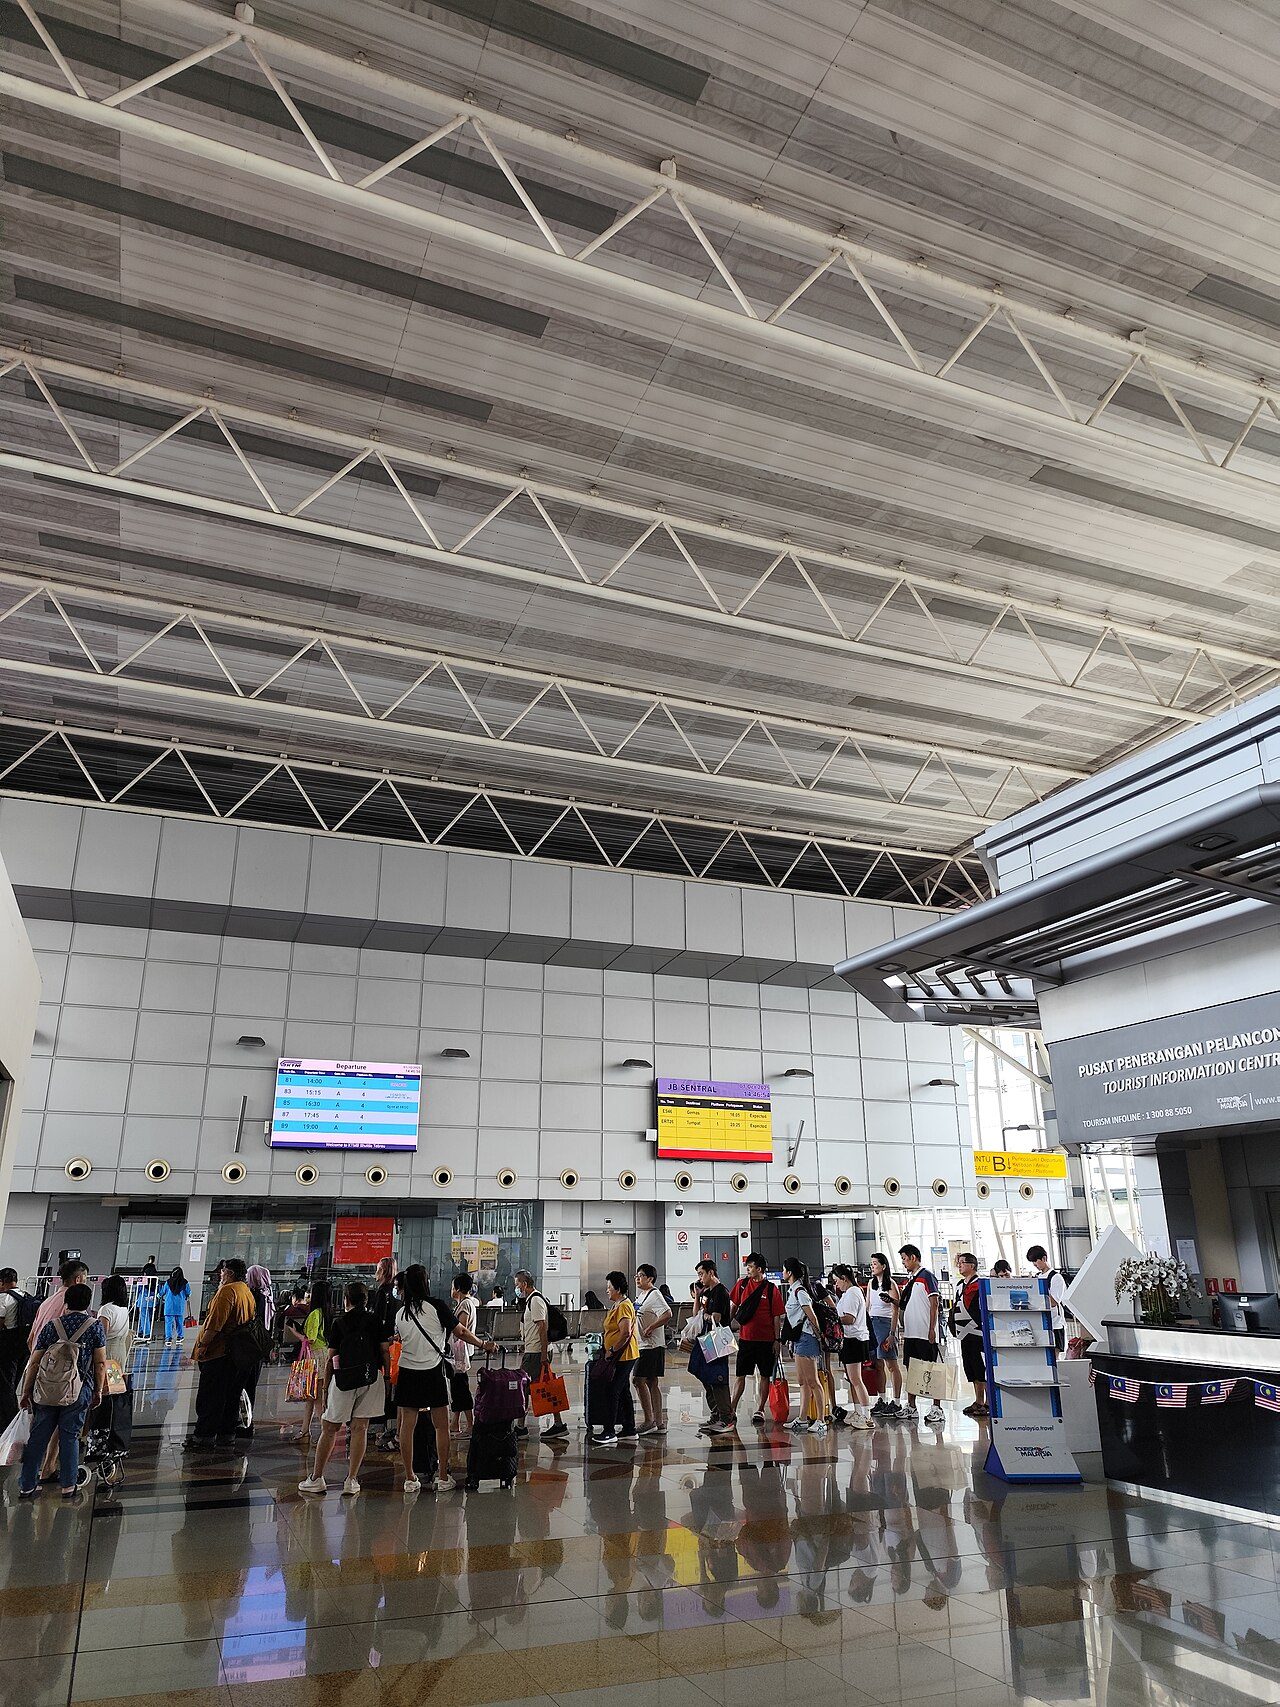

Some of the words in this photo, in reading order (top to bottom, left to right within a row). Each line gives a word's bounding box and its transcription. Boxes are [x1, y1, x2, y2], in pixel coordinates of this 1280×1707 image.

[1078, 1060, 1117, 1078] PUSAT
[1117, 1042, 1205, 1072] PENERANGAN
[336, 1063, 367, 1071] Departure
[1103, 1075, 1150, 1094] TOURIST
[1150, 1059, 1236, 1087] INFORMATION
[1238, 1052, 1280, 1073] CENTR
[667, 1083, 678, 1091] JB
[680, 1084, 717, 1093] SENTRAL
[1082, 1117, 1111, 1128] TOURISM
[1111, 1113, 1141, 1124] INFOLINE
[1145, 1111, 1151, 1120] 1
[1151, 1109, 1164, 1119] 300
[1164, 1108, 1174, 1117] 88
[1174, 1106, 1192, 1116] 5050
[992, 1156, 1006, 1171] B
[1004, 1424, 1054, 1432] www.malaysia.travel
[1020, 1450, 1052, 1459] MALAYSIA
